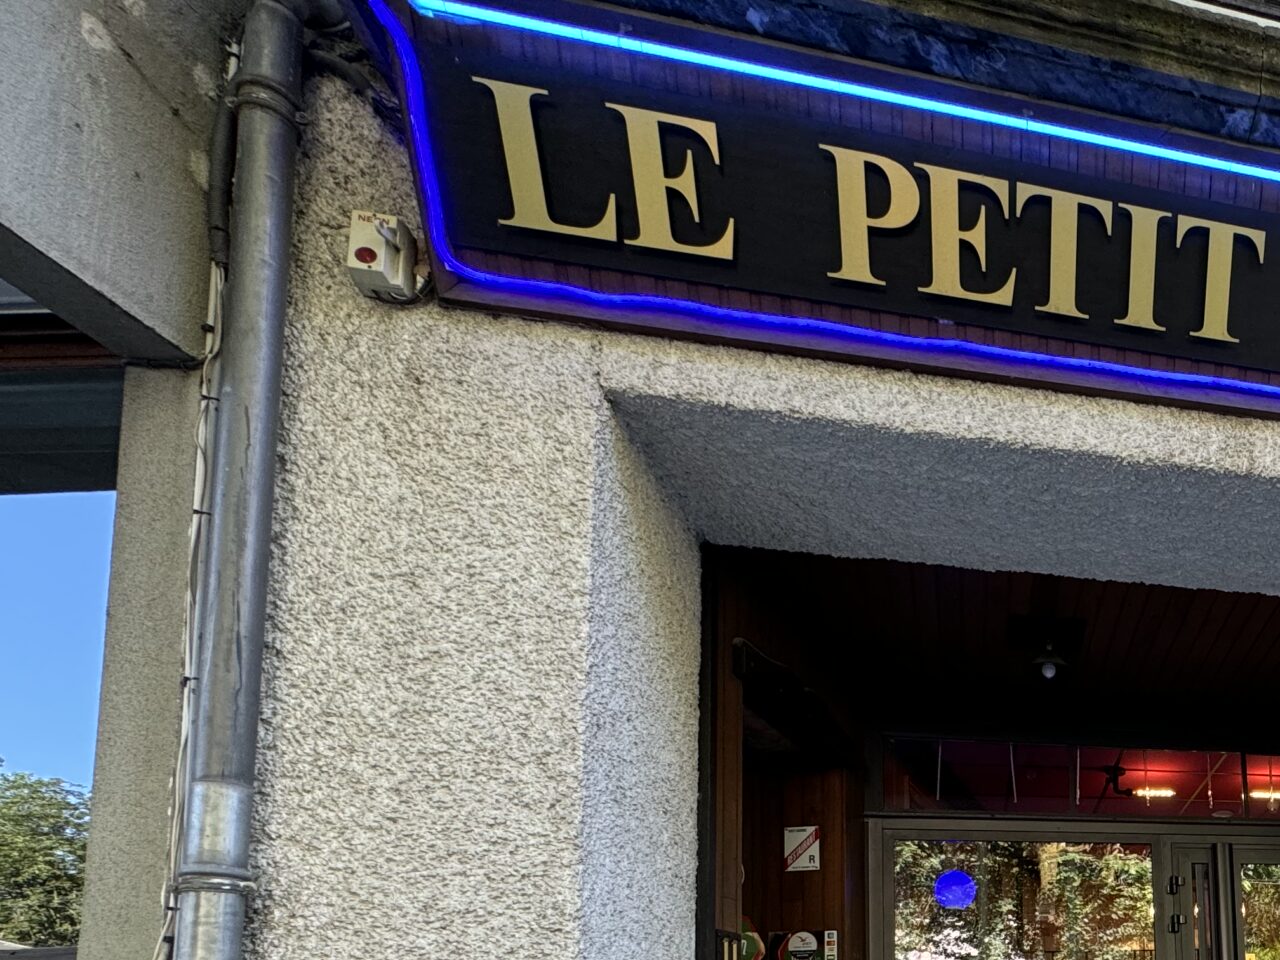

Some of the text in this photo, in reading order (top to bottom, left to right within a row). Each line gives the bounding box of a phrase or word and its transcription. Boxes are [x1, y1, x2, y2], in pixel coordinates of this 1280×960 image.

[472, 76, 735, 262] LE
[818, 143, 1267, 345] PETIT
[808, 854, 816, 864] R
